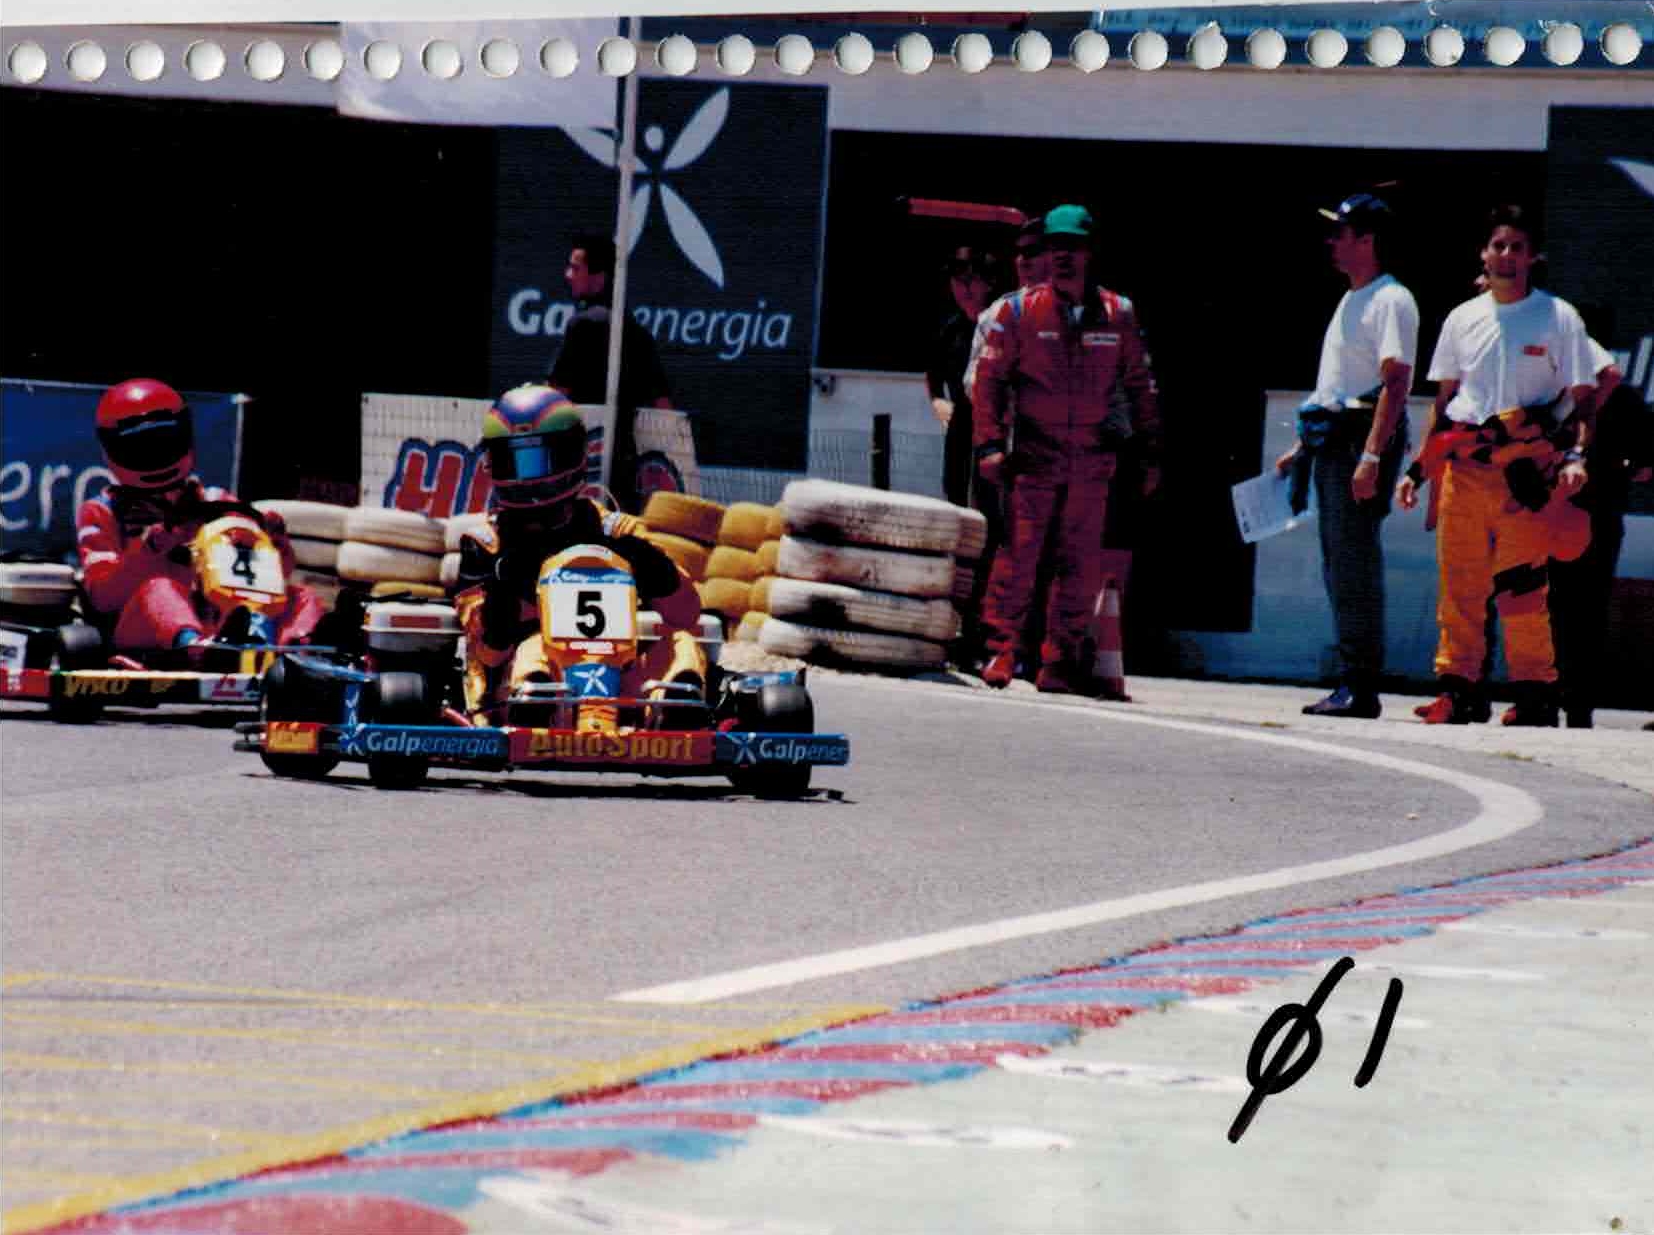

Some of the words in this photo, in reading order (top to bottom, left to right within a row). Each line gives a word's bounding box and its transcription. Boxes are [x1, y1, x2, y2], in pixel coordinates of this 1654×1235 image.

[231, 541, 256, 585] 4
[576, 590, 606, 639] 5
[365, 731, 498, 758] Galpenergia
